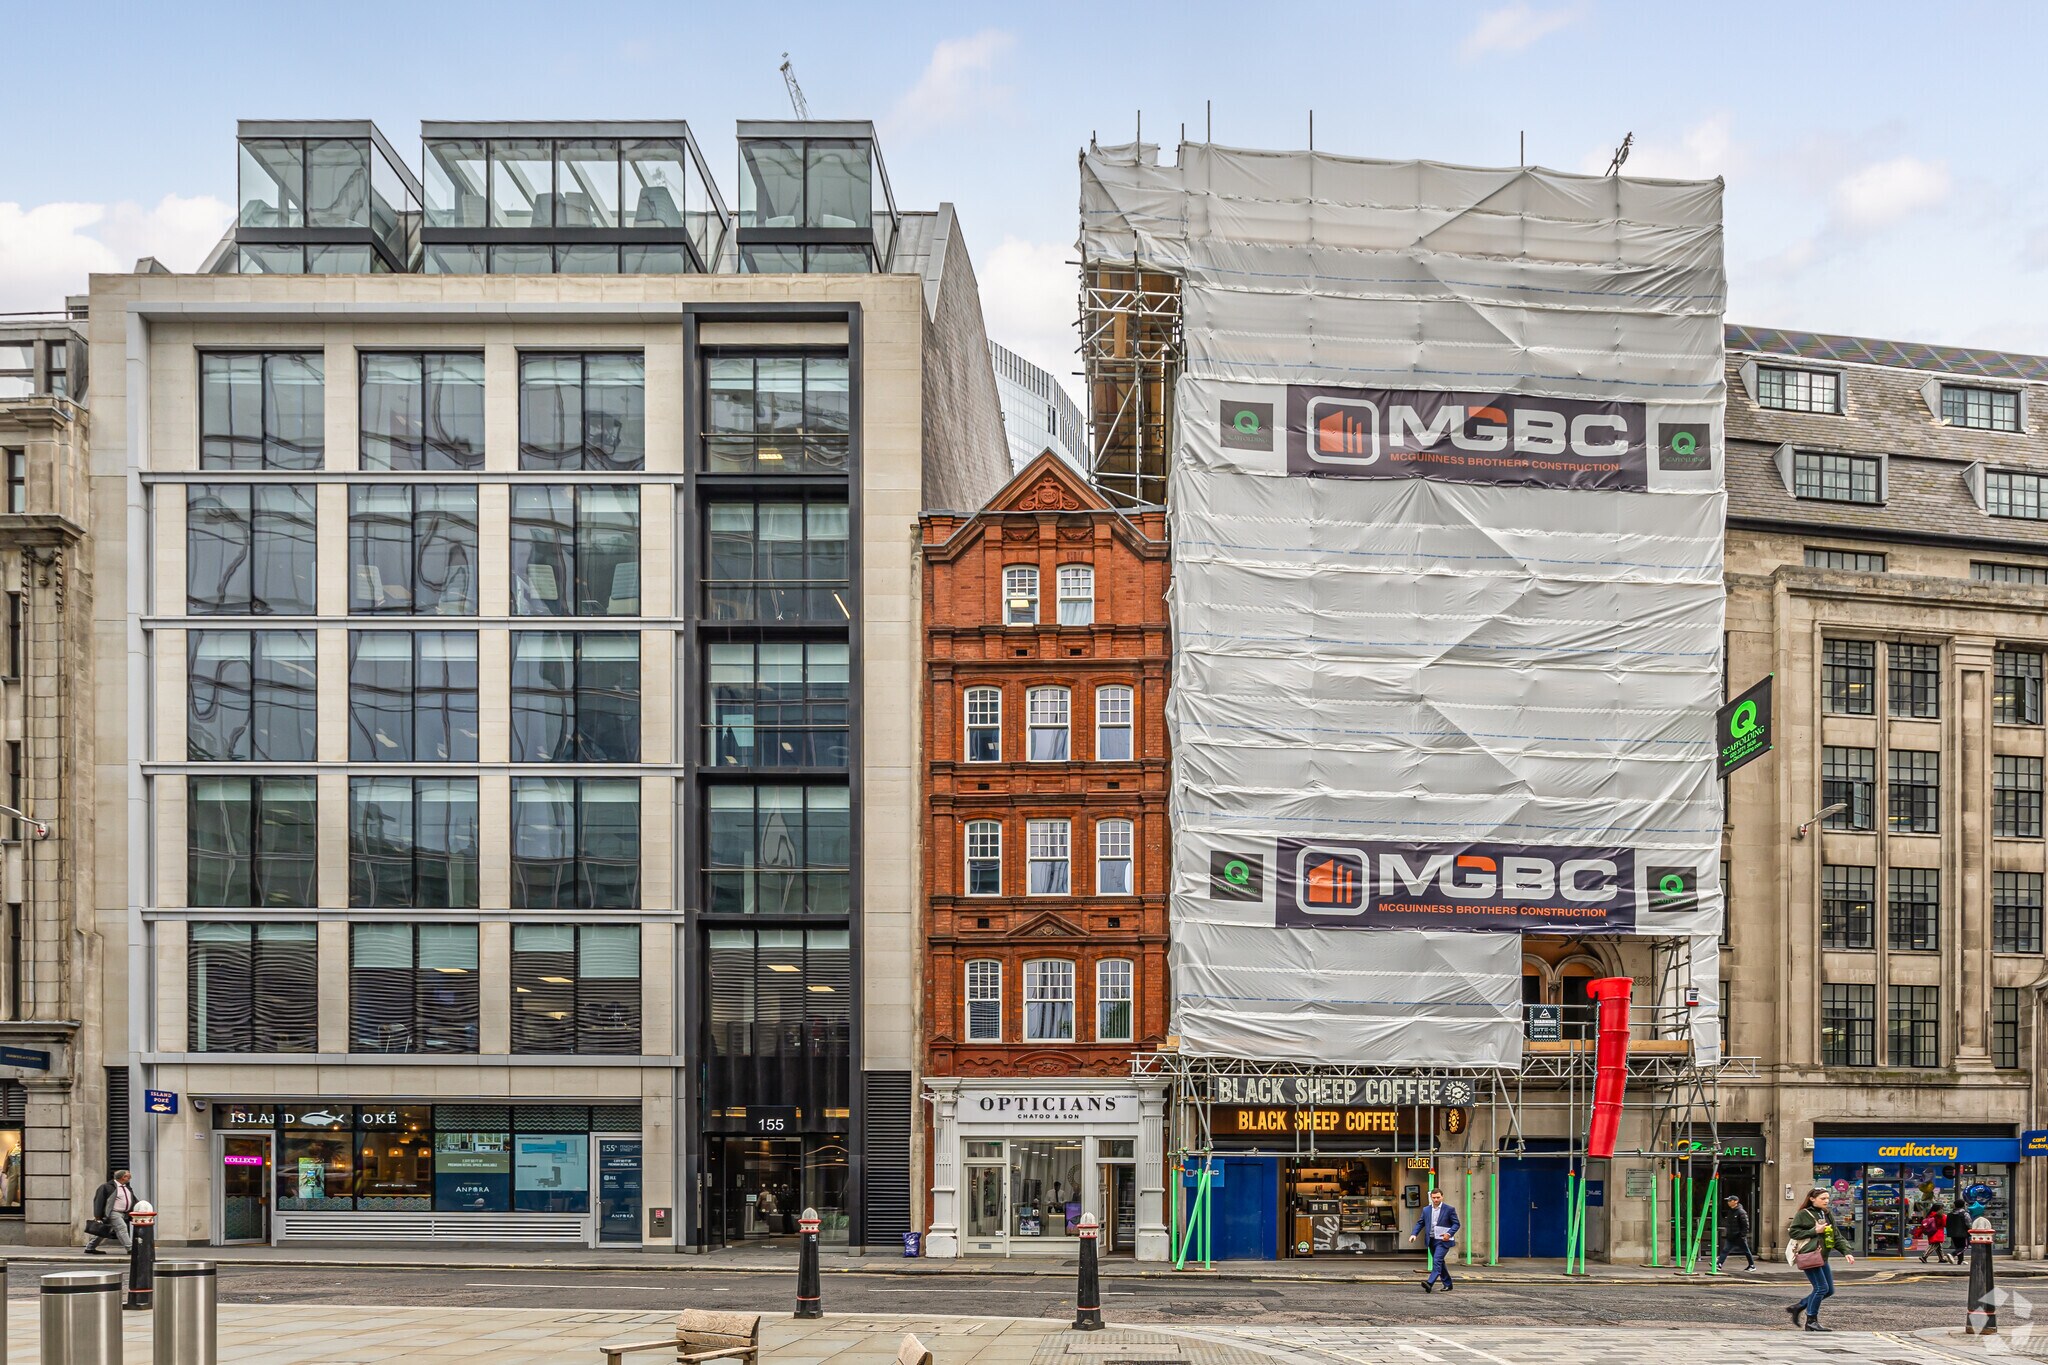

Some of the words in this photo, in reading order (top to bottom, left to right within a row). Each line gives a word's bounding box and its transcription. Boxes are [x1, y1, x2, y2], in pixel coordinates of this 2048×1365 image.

[1389, 405, 1629, 457] MGBC
[1390, 453, 1465, 465] MCGUINNESS
[1467, 457, 1528, 468] BROTHERS
[1532, 460, 1619, 472] CONSTRUCTION
[1730, 700, 1758, 739] Q
[1722, 725, 1765, 757] SCAFFOLDING
[1379, 853, 1618, 902] MGBC
[1378, 903, 1453, 914] MCGUINNESS
[1456, 905, 1518, 915] BROTHERS
[1520, 907, 1607, 917] CONSTRUCTION
[1218, 1077, 1286, 1103] BLACK
[1295, 1077, 1357, 1104] SHEEP
[1365, 1078, 1441, 1105] COFFEE
[979, 1096, 1116, 1111] OPTICIANS
[230, 1113, 295, 1124] ISLAD
[353, 1111, 397, 1124] OKÉ
[758, 1118, 784, 1131] 155
[1238, 1111, 1287, 1130] BLACK
[1295, 1111, 1340, 1131] SHEEP
[1346, 1111, 1399, 1131] COFFEE
[1878, 1142, 1958, 1160] cardfactory
